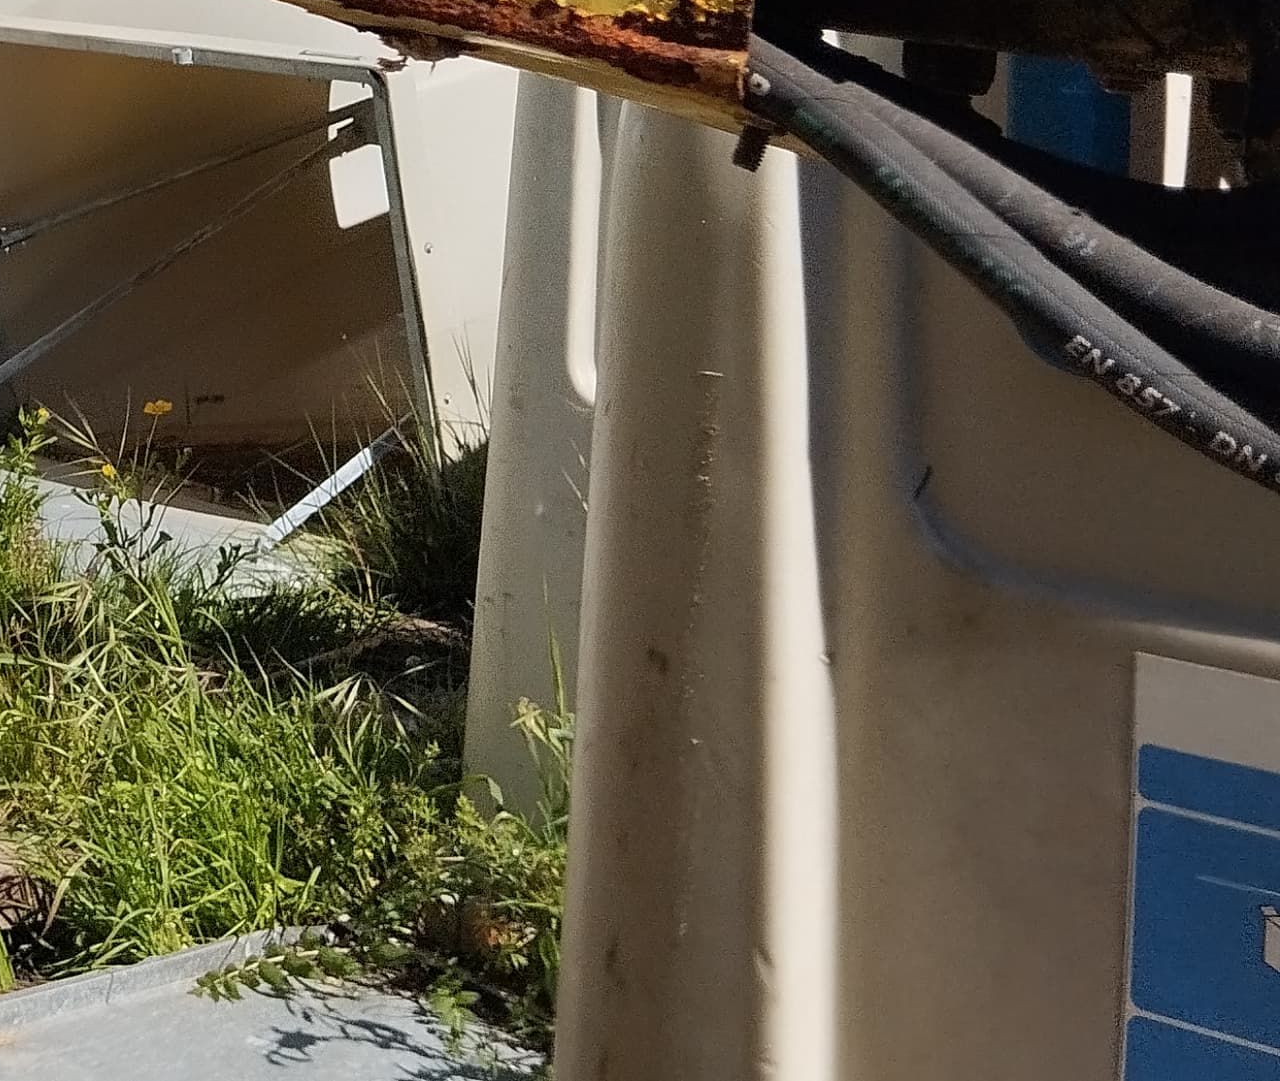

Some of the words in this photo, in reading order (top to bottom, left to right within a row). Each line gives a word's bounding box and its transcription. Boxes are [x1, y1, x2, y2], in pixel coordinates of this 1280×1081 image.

[1063, 334, 1116, 375] EN
[1117, 373, 1182, 416] 857
[1210, 430, 1268, 470] DN
